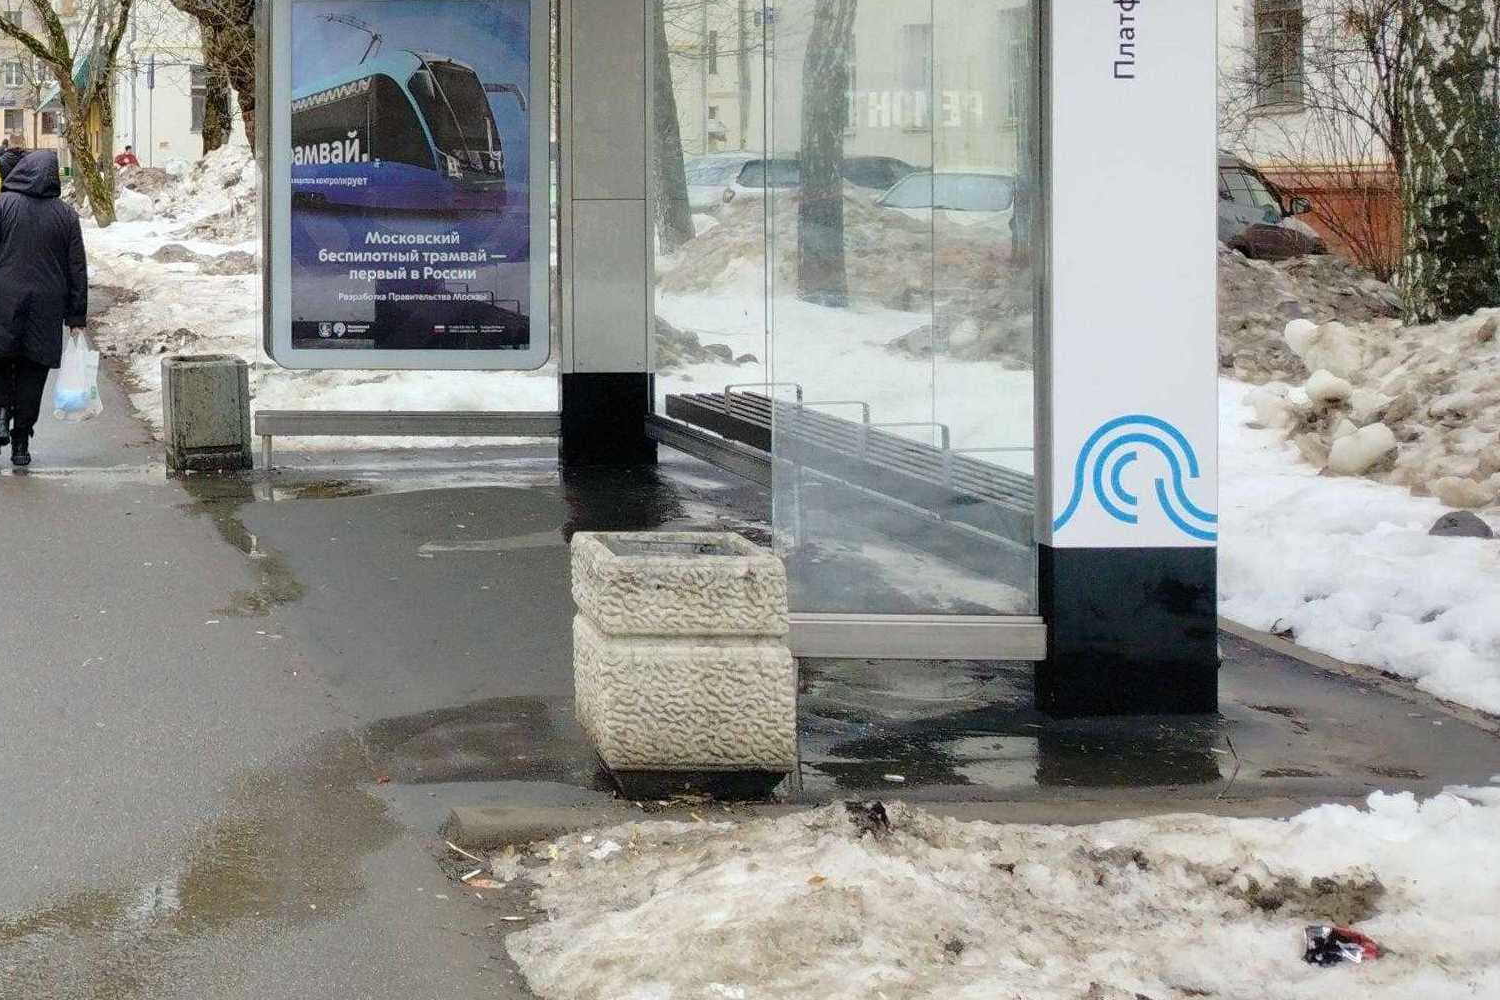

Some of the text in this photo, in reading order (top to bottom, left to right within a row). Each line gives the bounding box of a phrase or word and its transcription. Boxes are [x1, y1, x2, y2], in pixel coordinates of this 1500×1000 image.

[364, 231, 460, 245] Московский
[318, 248, 419, 262] беспилотный
[422, 249, 487, 264] трамвай
[349, 266, 477, 281] первый в России
[338, 292, 488, 302] Разработка Правительства Москвы
